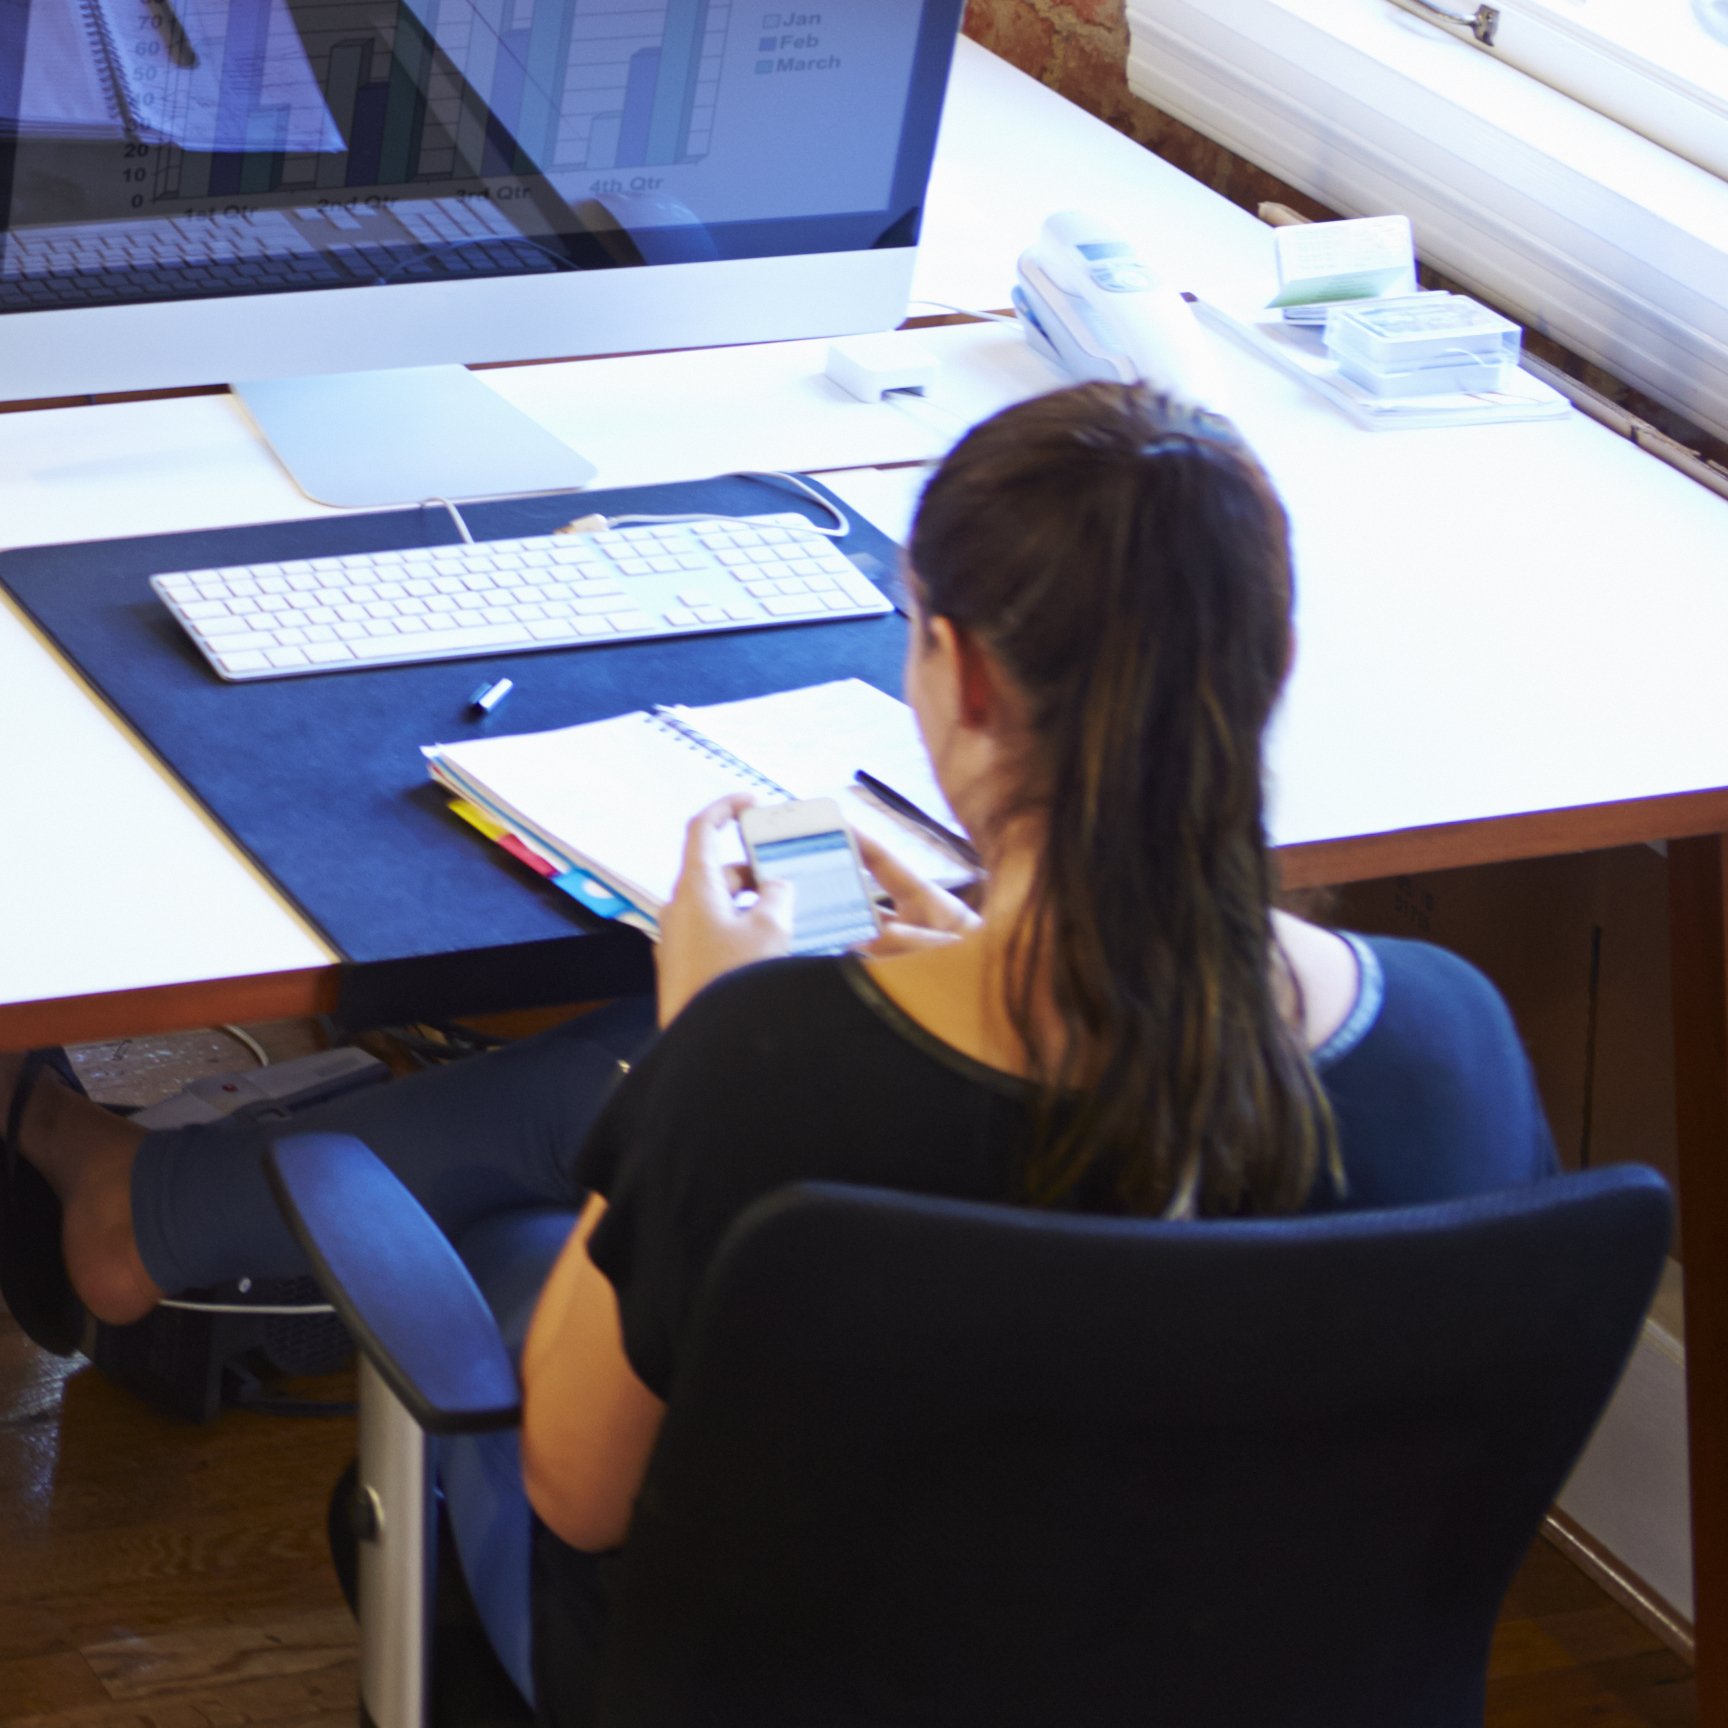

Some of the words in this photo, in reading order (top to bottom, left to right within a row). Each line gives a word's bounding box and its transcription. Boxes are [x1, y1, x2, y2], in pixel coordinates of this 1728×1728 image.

[137, 14, 163, 31] 70
[782, 11, 822, 27] Jan
[135, 41, 160, 57] 60
[780, 33, 819, 49] Feb
[775, 54, 841, 73] March
[132, 66, 158, 82] 50
[123, 143, 149, 159] 20
[122, 167, 146, 183] 10
[456, 185, 491, 200] 3rd
[497, 184, 532, 201] Qtr
[588, 177, 624, 194] 4th
[630, 175, 665, 194] Qtr
[130, 194, 144, 209] 0
